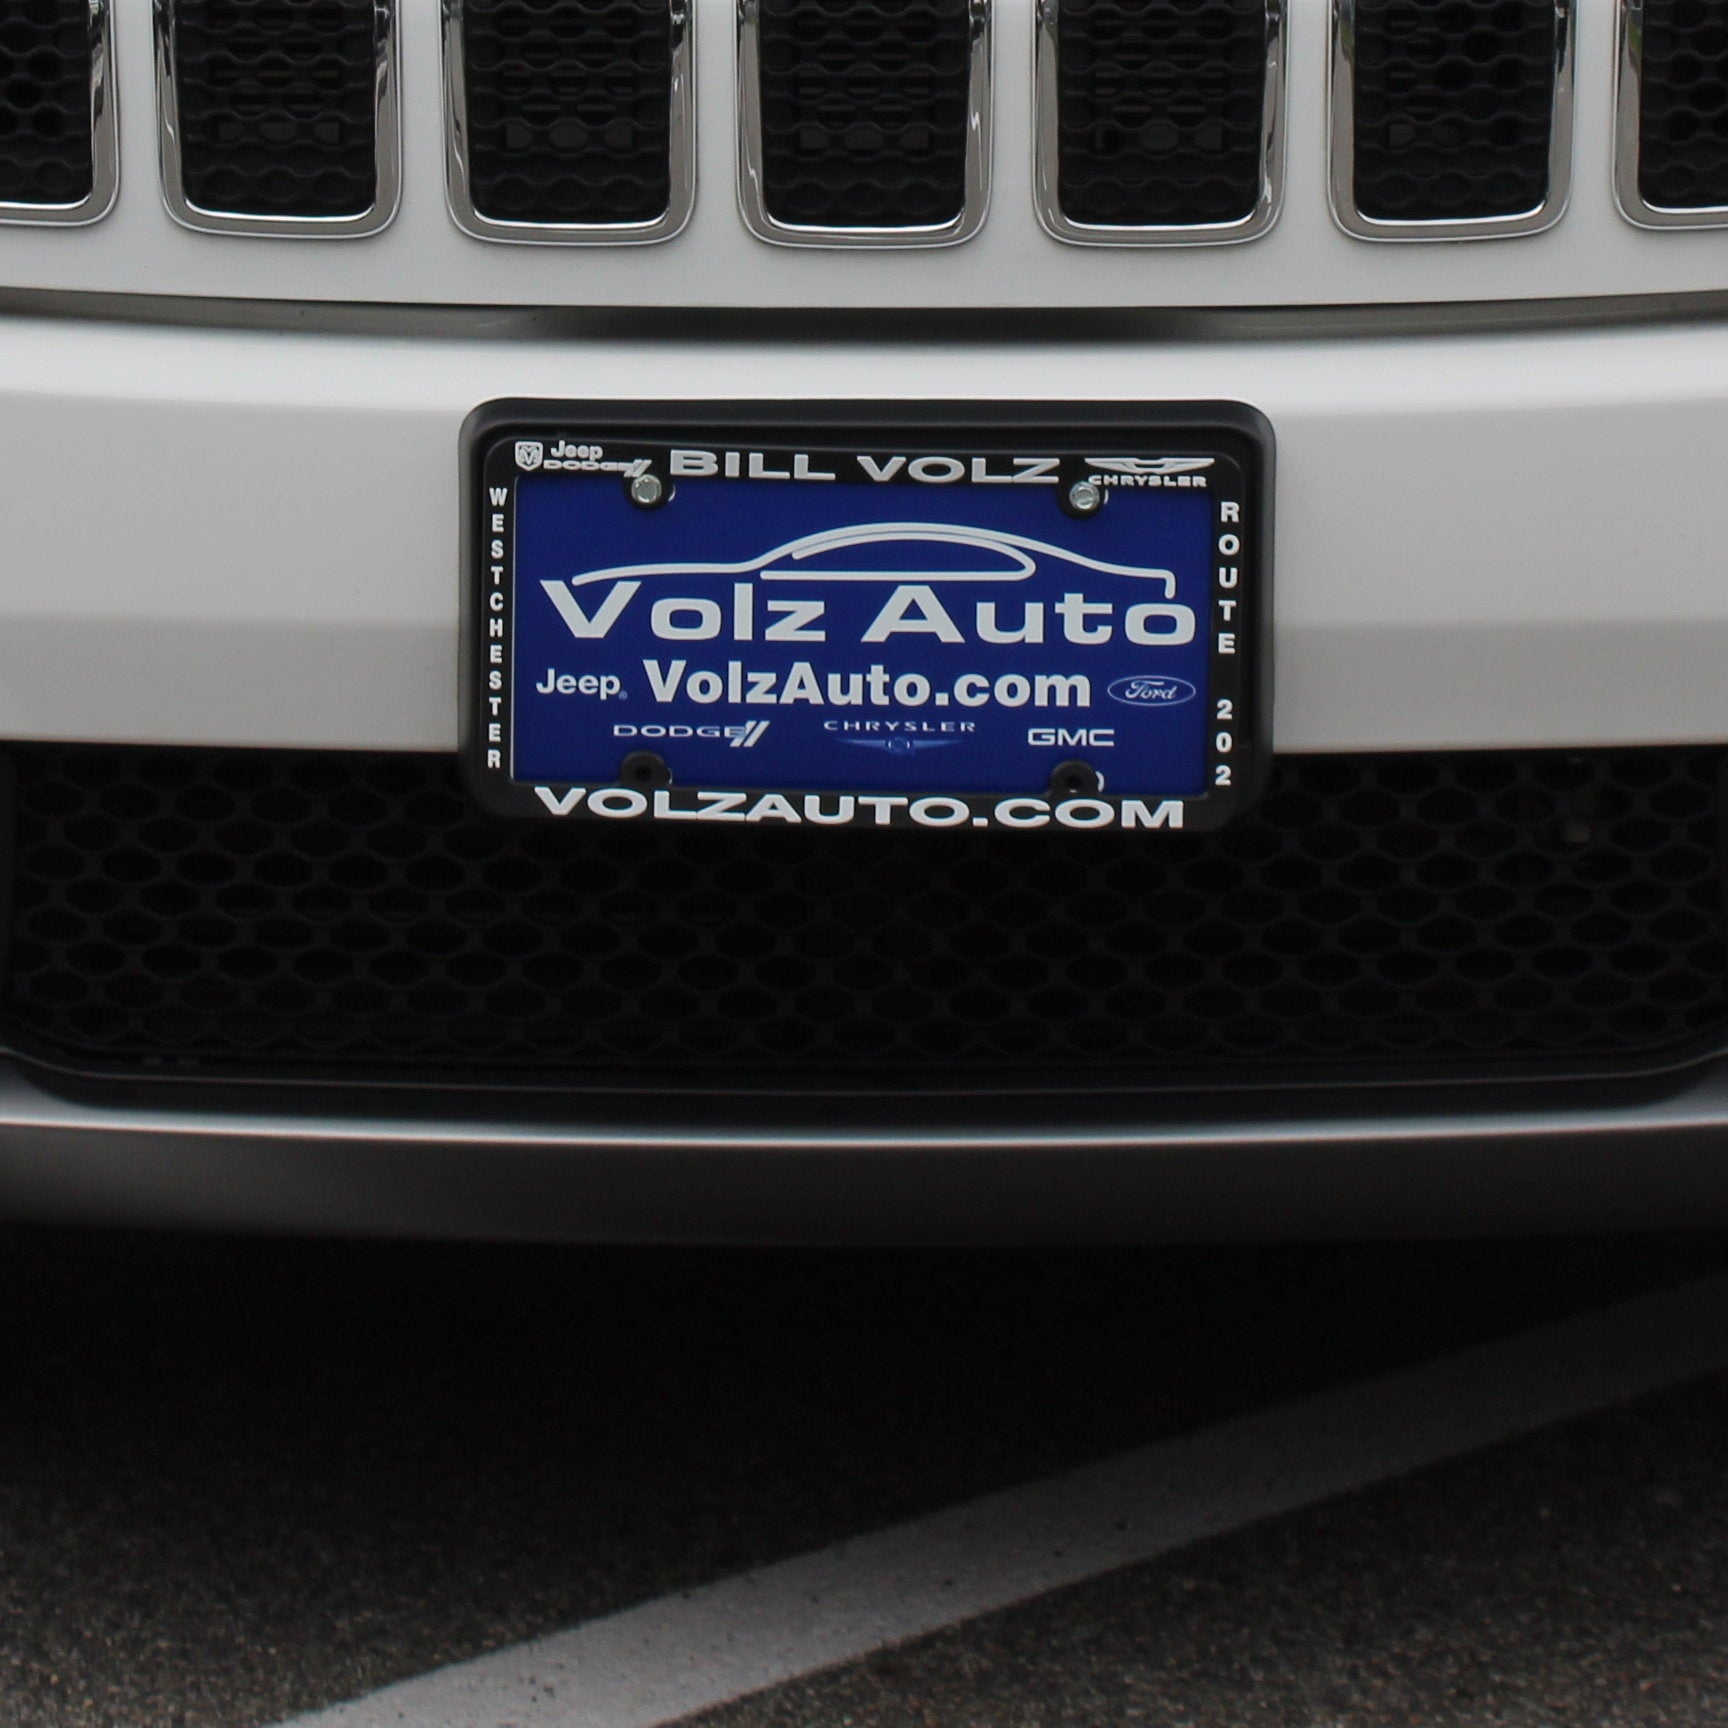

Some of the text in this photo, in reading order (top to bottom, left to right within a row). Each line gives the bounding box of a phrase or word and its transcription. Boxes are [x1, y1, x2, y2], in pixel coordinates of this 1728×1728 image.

[550, 440, 604, 461] Jeep
[670, 449, 1060, 484] BILL VOLZ
[1088, 474, 1208, 487] CHRYSLER
[487, 487, 508, 769] WESTCHESTER
[540, 579, 1196, 646] Volz Auto
[1214, 501, 1240, 786] ROUTE 202
[535, 668, 621, 700] Jeep
[643, 658, 1091, 707] VolzAuto.com
[1124, 680, 1178, 701] Ford
[613, 724, 746, 739] DODGE
[823, 721, 976, 733] CHRYSLER
[1027, 728, 1115, 747] GMC
[534, 786, 1184, 830] VOLZAUTO.COM
